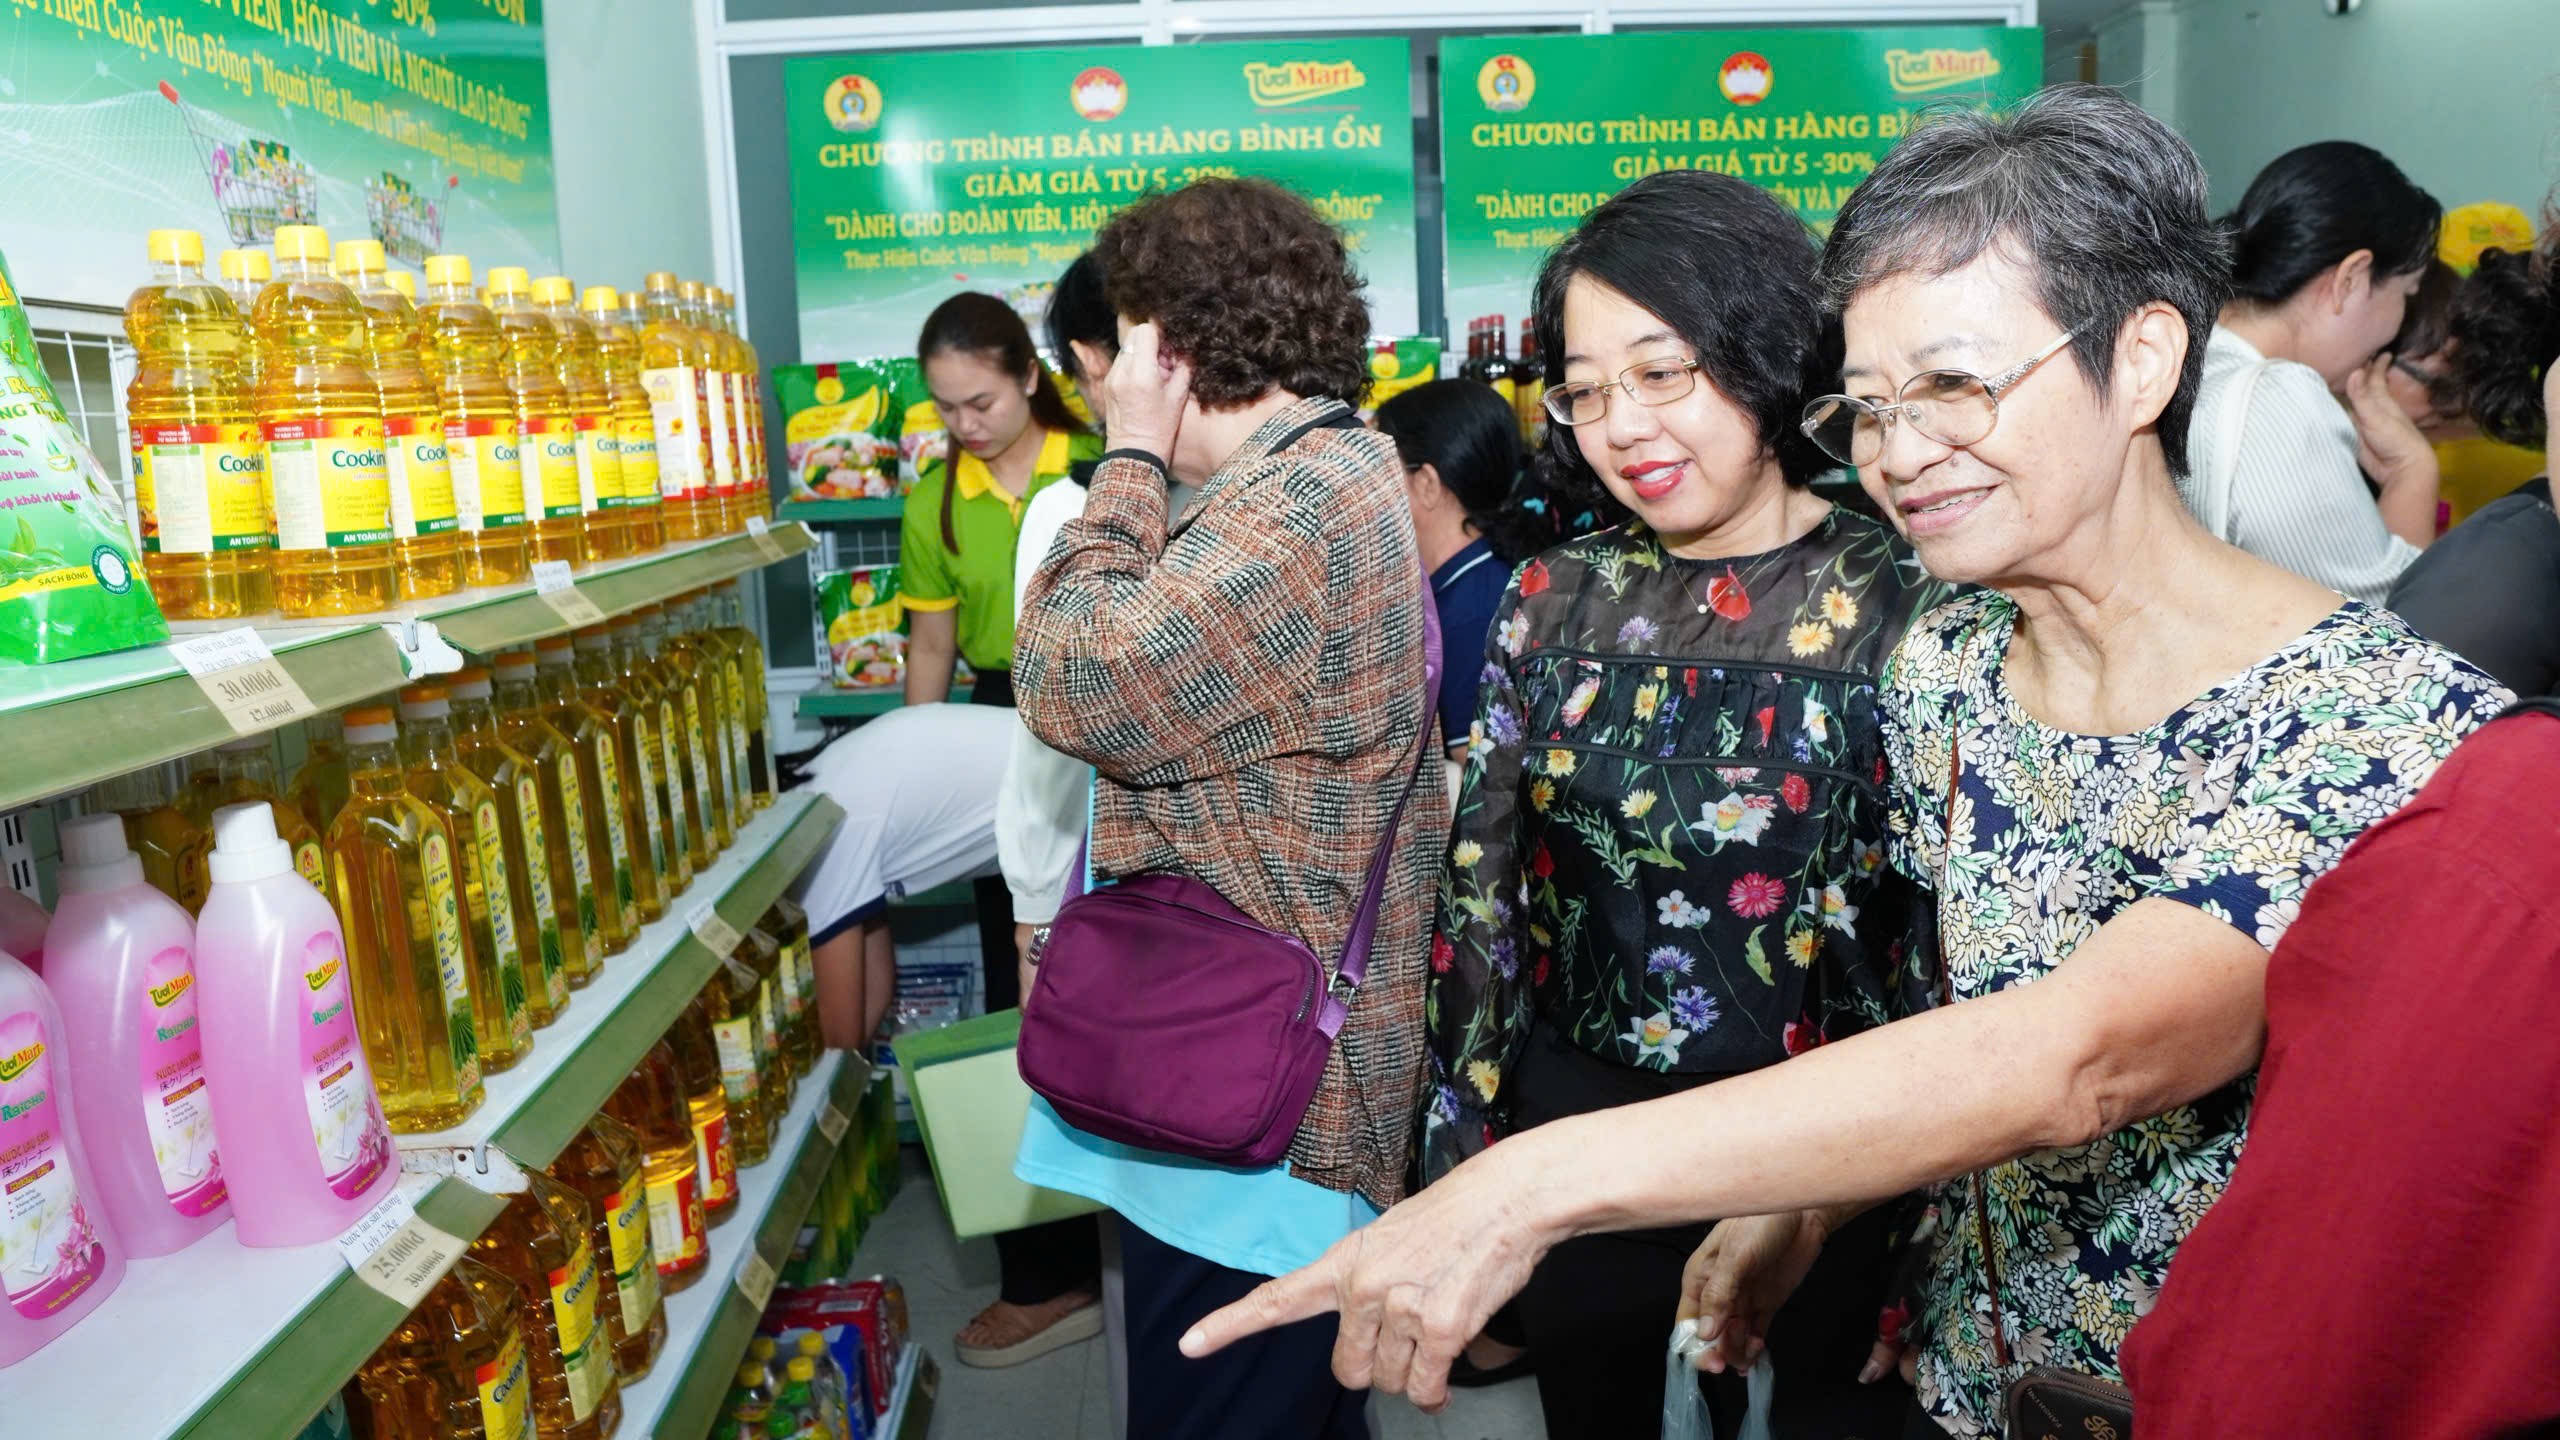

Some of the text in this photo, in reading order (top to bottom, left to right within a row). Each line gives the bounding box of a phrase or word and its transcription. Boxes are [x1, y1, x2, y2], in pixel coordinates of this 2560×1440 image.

[159, 15, 201, 77] Vận
[202, 33, 252, 97] Động
[1932, 52, 1987, 75] Mart
[1294, 61, 1353, 87] Mart
[950, 130, 1045, 162] TRÌNH
[1051, 128, 1122, 159] BÁN
[1132, 124, 1232, 155] HÀNG
[1240, 121, 1325, 152] BÌNH
[1332, 114, 1383, 148] ỔN
[1471, 122, 1596, 147] CHƯƠNG
[1600, 113, 1692, 143] TRÌNH
[1700, 112, 1766, 142] BÁN
[1776, 110, 1870, 138] HÀNG
[1613, 146, 1878, 179] GIẢM GIÁ TỪ 5 -30%
[964, 165, 1044, 198] GIẢM
[1050, 163, 1103, 194] GIÁ
[1106, 161, 1148, 193] TỪ
[1152, 167, 1168, 191] 5
[1476, 189, 1545, 219] "DÀNH
[1549, 192, 1593, 217] CHO
[825, 209, 896, 240] "DÀNH
[901, 209, 945, 238] CHO
[949, 203, 1009, 235] ĐOÀN
[1012, 201, 1068, 233] VIÊN,
[343, 533, 356, 543] AN
[357, 531, 377, 542] TOÀN
[321, 959, 339, 977] Mart
[170, 974, 190, 993] Mart
[17, 1043, 41, 1066] Mart
[358, 1222, 370, 1235] lau
